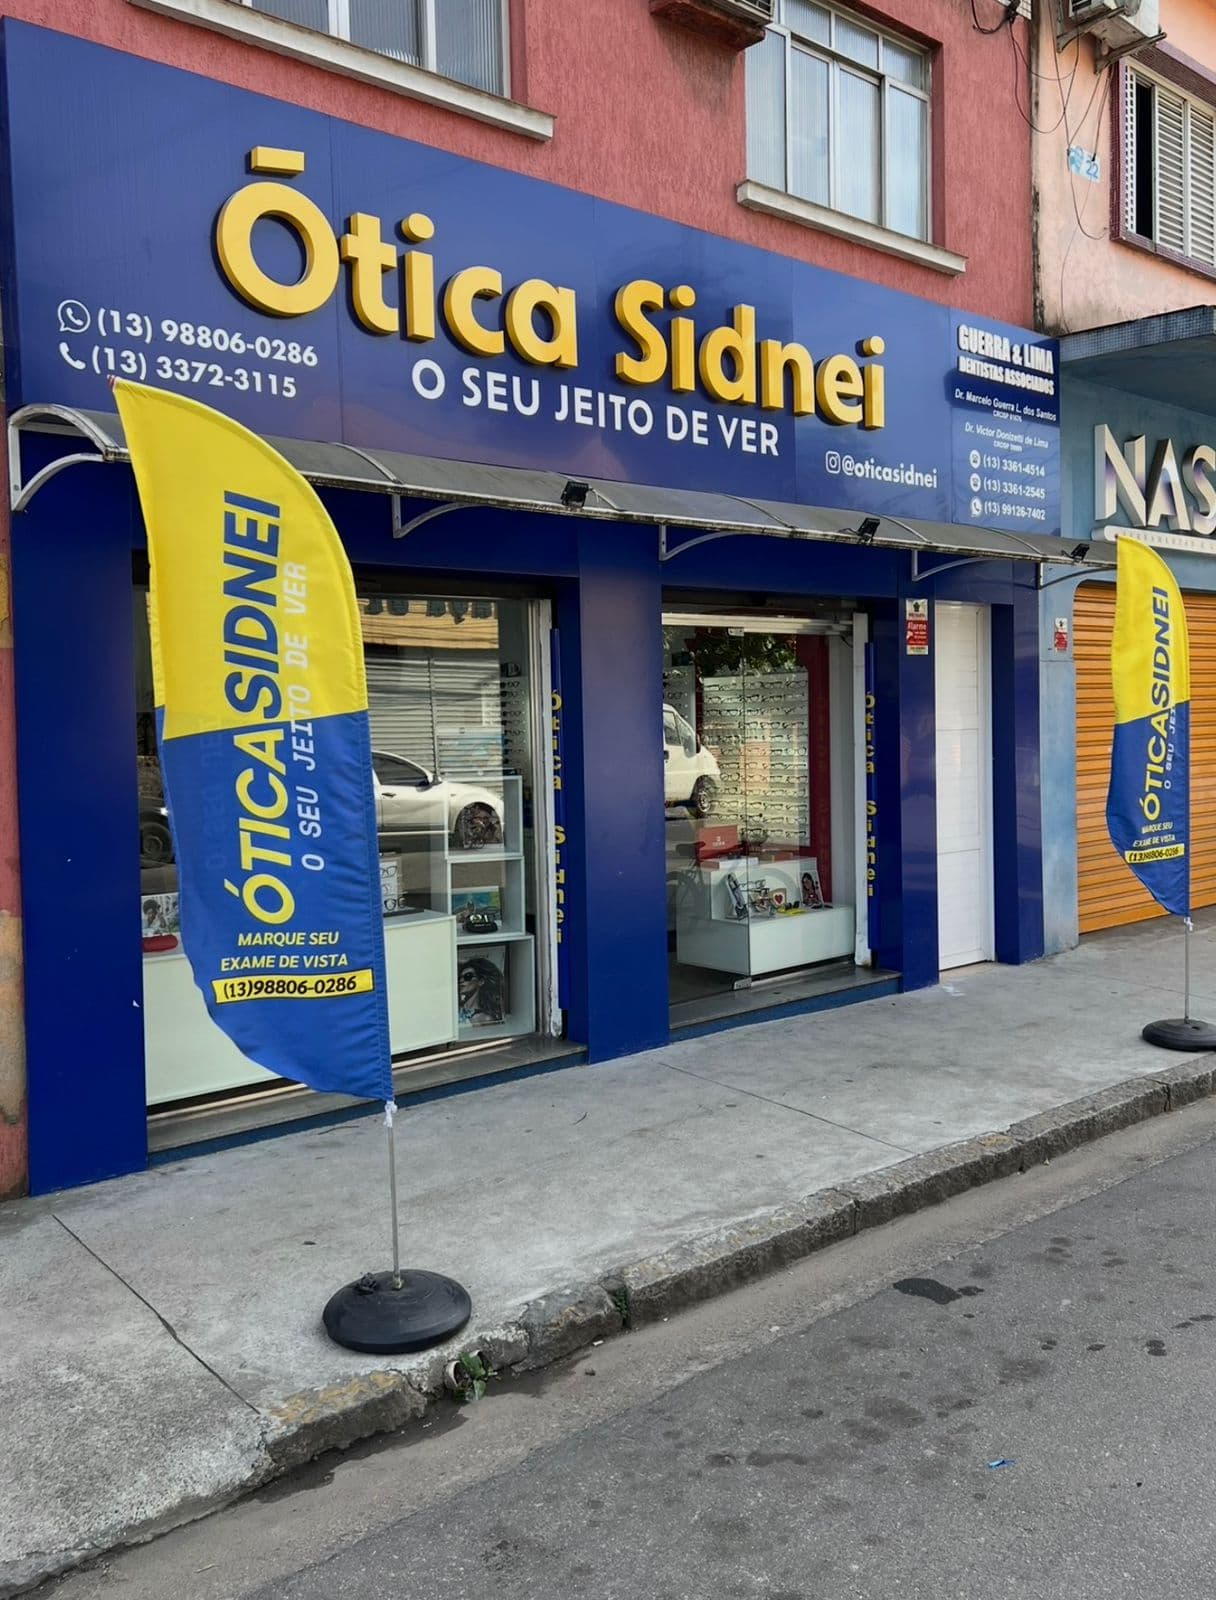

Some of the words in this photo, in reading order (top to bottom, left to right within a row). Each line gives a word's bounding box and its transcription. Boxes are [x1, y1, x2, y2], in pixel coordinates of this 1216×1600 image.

[98, 307, 152, 343] (13)
[161, 320, 319, 368] 98806-0286
[958, 324, 1011, 363] GUERRA
[1012, 344, 1023, 366] &
[1023, 344, 1054, 375] LIMA
[92, 345, 146, 380] (13)
[156, 356, 297, 398] 3372-3115
[615, 280, 886, 430] Sidnei
[958, 355, 1004, 383] DENTISTAS
[1004, 368, 1055, 396] ASSOCIADOS
[412, 359, 446, 400] O
[462, 367, 540, 416] SEU
[555, 384, 654, 436] JEITO
[666, 405, 709, 446] DE
[718, 414, 779, 457] VER
[955, 388, 965, 399] Dr.
[966, 390, 992, 406] Marcelo
[993, 398, 1015, 411] Guerra
[1023, 405, 1035, 416] dos
[1036, 408, 1057, 421] Santos
[965, 421, 974, 433] Dr.
[976, 424, 995, 437] Victor
[1025, 435, 1033, 445] de
[1034, 437, 1049, 449] Lima
[842, 455, 938, 489] @oticasidnei
[983, 454, 1001, 471] (13)
[1002, 459, 1045, 477] 3361-4514
[983, 477, 1001, 493] (13)
[1002, 481, 1046, 500] 3361-2545
[984, 500, 1001, 515] (13)
[1001, 503, 1046, 520] 99126-7402
[283, 560, 307, 616] VER
[284, 631, 309, 669] DE
[290, 684, 316, 771] JEITO
[1165, 743, 1175, 772] SEU
[1163, 779, 1172, 790] O
[297, 785, 322, 838] SEU
[301, 853, 325, 872] O
[866, 800, 878, 897] Sidnei
[238, 932, 306, 947] MARQUE
[308, 931, 339, 945] SEU
[221, 956, 277, 971] EXAME
[278, 955, 300, 969] DE
[302, 953, 349, 968] VISTA
[223, 976, 357, 1000] (13)98806-0286
